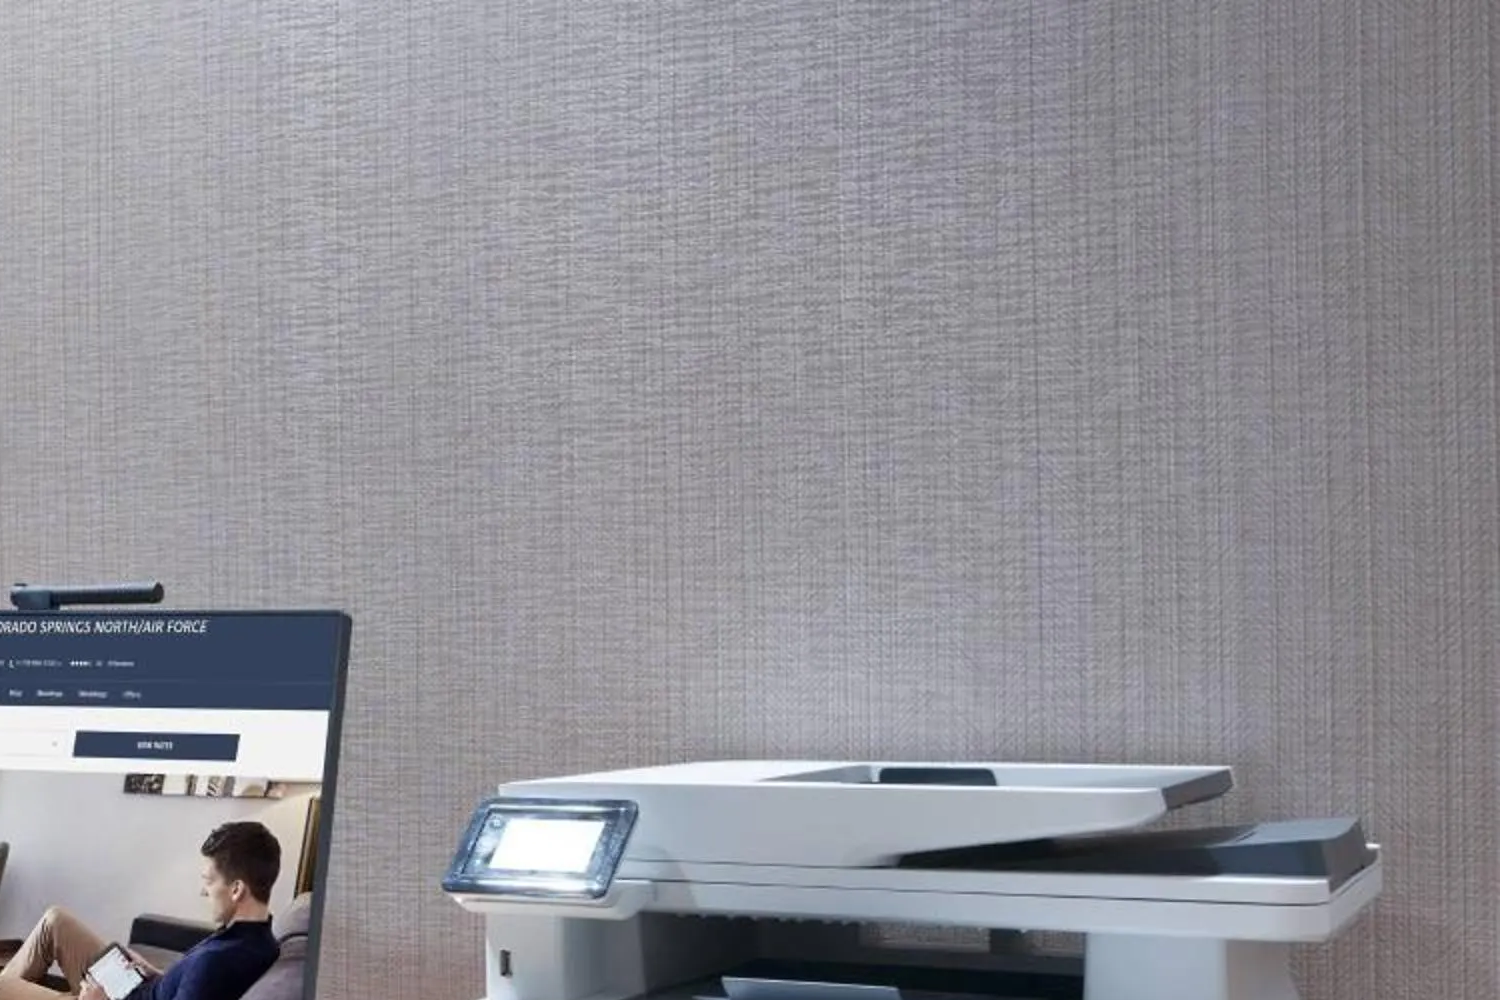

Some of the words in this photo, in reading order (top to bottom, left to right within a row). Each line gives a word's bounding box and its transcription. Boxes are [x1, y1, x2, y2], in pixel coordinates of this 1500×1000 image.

[39, 620, 92, 635] SPRINGS
[93, 619, 164, 635] NORTH/AIR
[166, 619, 209, 634] FORCE
